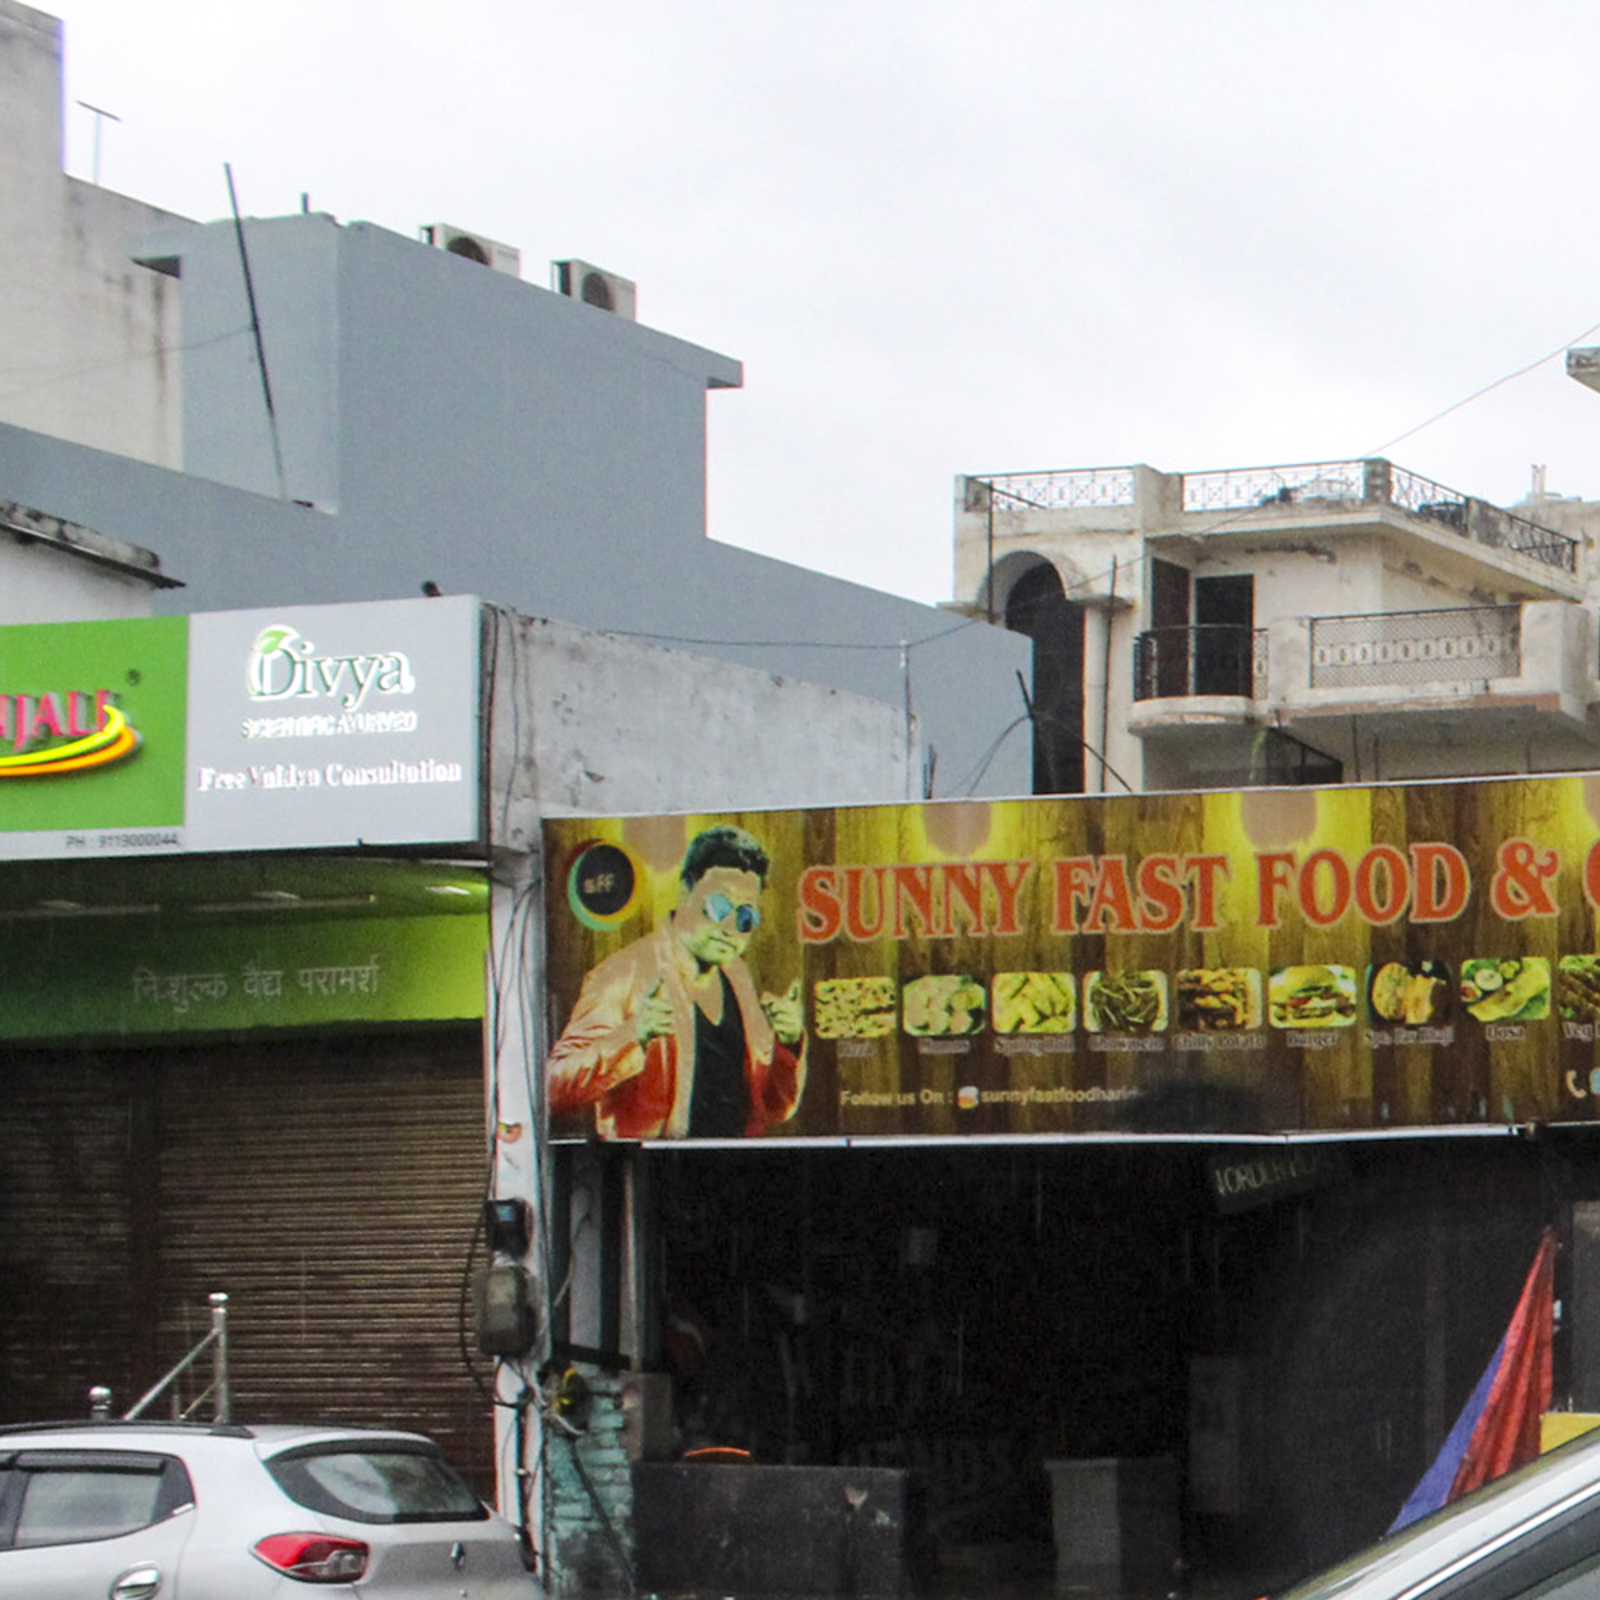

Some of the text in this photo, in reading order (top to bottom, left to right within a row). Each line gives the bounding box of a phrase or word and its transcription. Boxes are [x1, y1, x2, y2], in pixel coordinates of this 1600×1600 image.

[246, 624, 416, 711] Divya
[198, 766, 247, 792] Free
[326, 758, 462, 787] Consultation
[800, 858, 1031, 946] SUNNY
[1054, 853, 1230, 937] FAST
[1255, 843, 1471, 930] FOOD
[1490, 836, 1560, 921] &
[1486, 1024, 1527, 1041] Dosa
[1562, 1021, 1593, 1042] Veg
[840, 1089, 893, 1106] Follow
[897, 1092, 916, 1105] us
[919, 1088, 945, 1104] On
